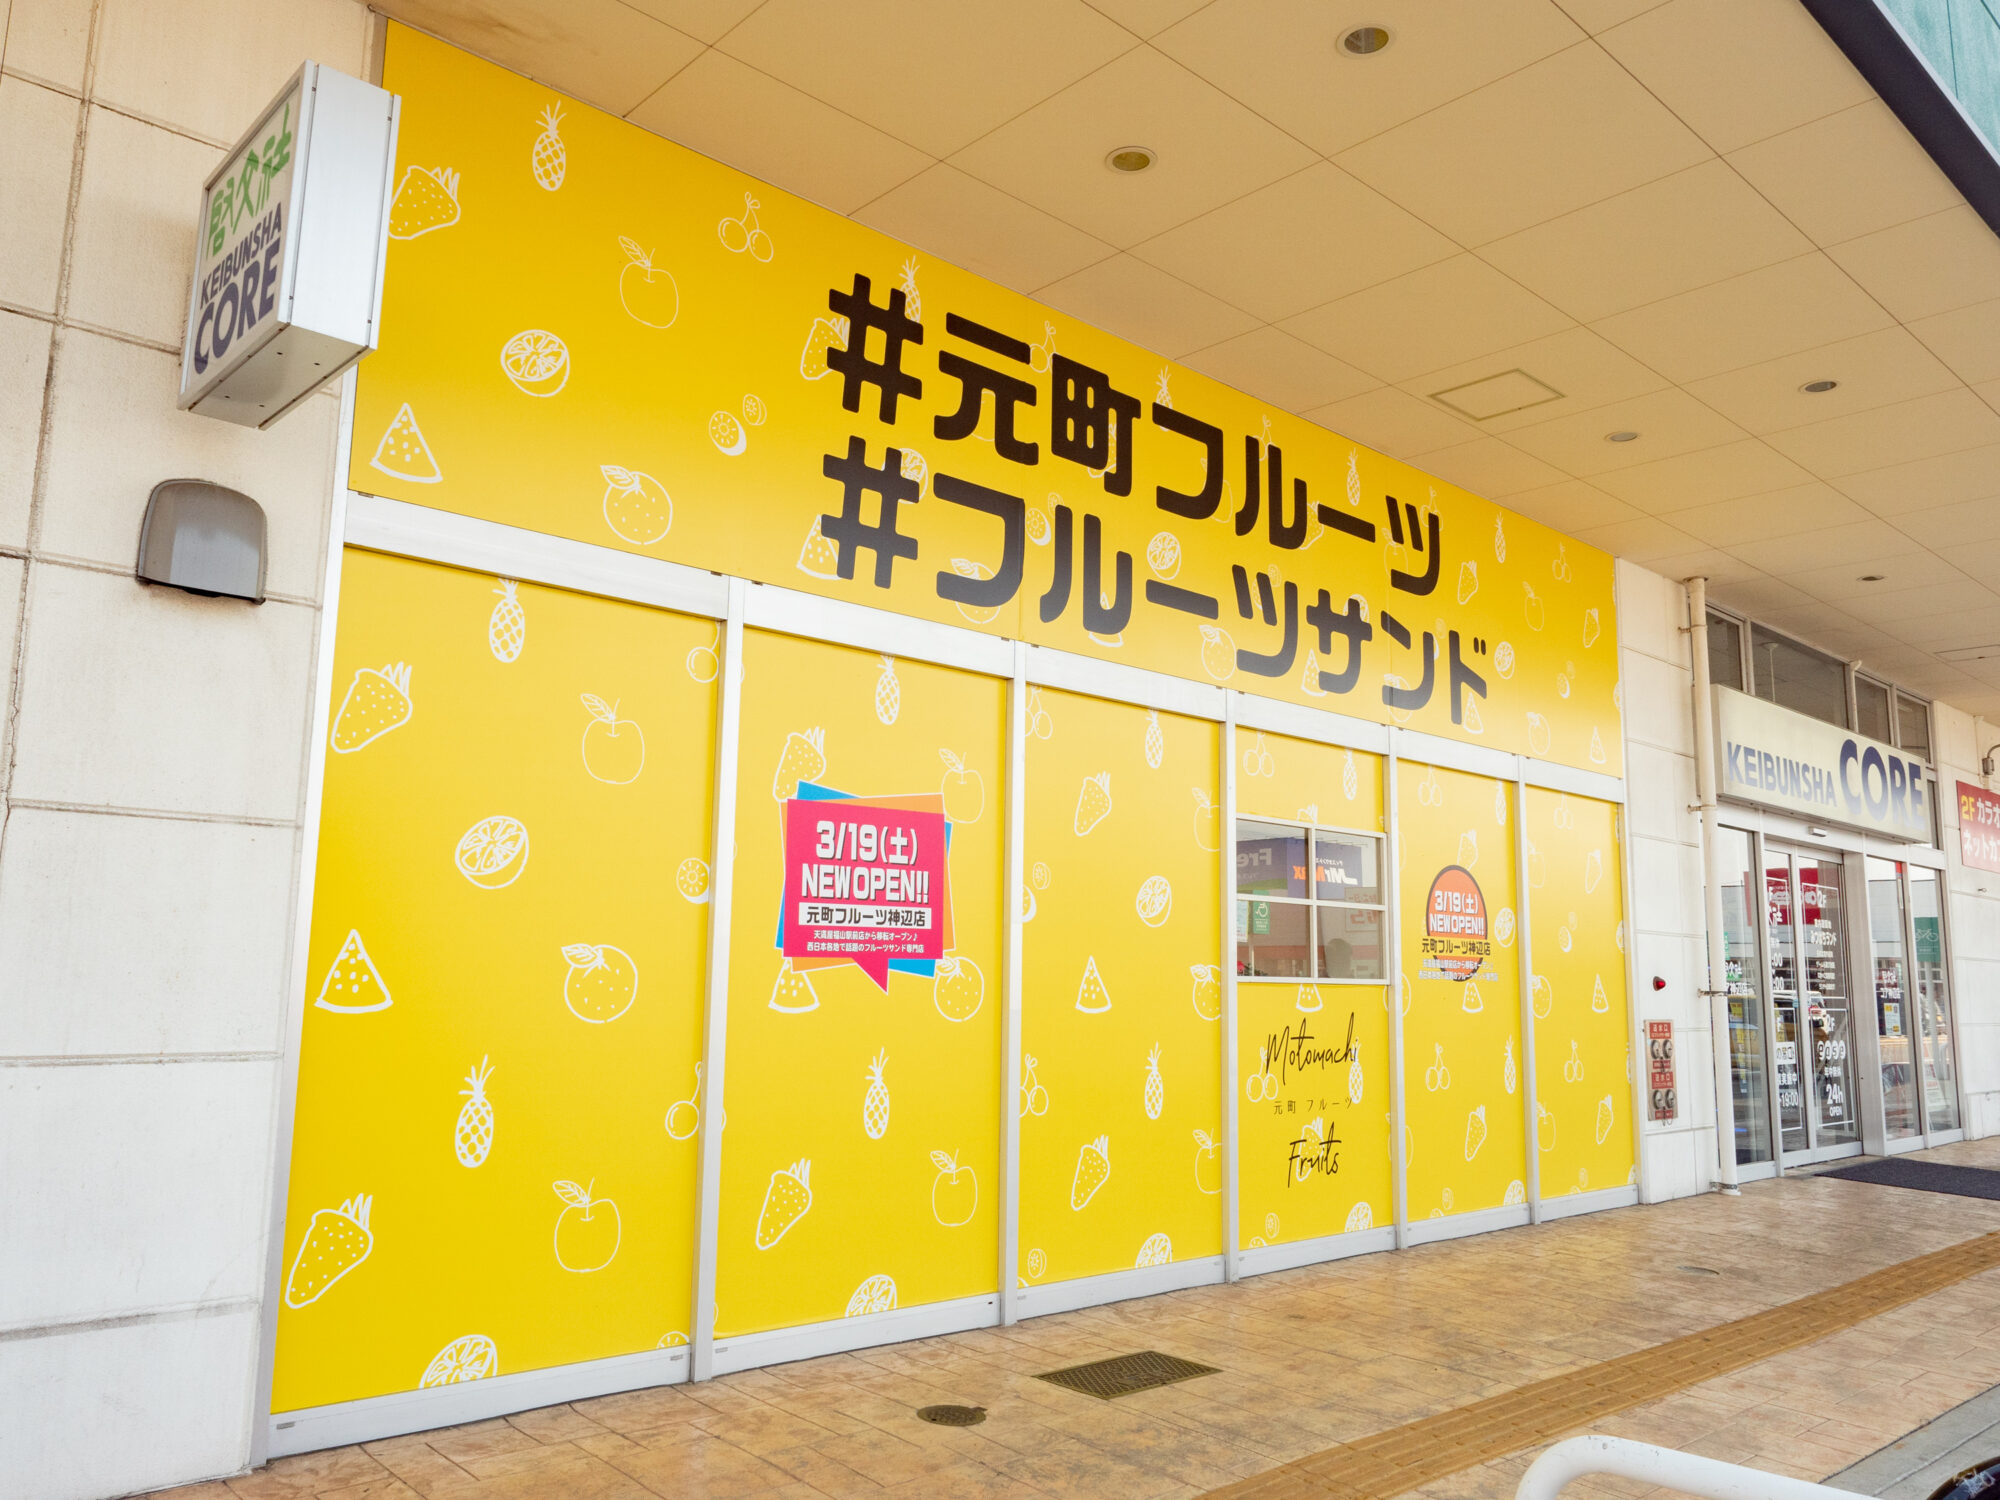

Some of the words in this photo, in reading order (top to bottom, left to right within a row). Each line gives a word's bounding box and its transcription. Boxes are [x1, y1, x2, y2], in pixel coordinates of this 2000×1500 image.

[200, 202, 282, 309] KEIBUNSHA
[194, 237, 281, 374] CORE
[827, 273, 1440, 596] #元町フルーツ
[821, 436, 1487, 725] #フルーツサンド
[1727, 741, 1837, 807] KEIBUNSHA
[1839, 738, 1926, 831] CORE
[1961, 795, 1975, 822] 2F
[816, 820, 918, 865] 3/19(土)
[802, 863, 851, 898] NEW
[853, 867, 930, 904] OPEN!!
[1434, 890, 1479, 915] 3/19(土)
[806, 906, 926, 926] 元町フルーツ神辺店
[1429, 913, 1451, 933] NEW
[1422, 938, 1491, 956] 元町フルーツ神辺店
[1266, 1012, 1358, 1086] Motomachi
[1287, 1121, 1342, 1188] Fruits
